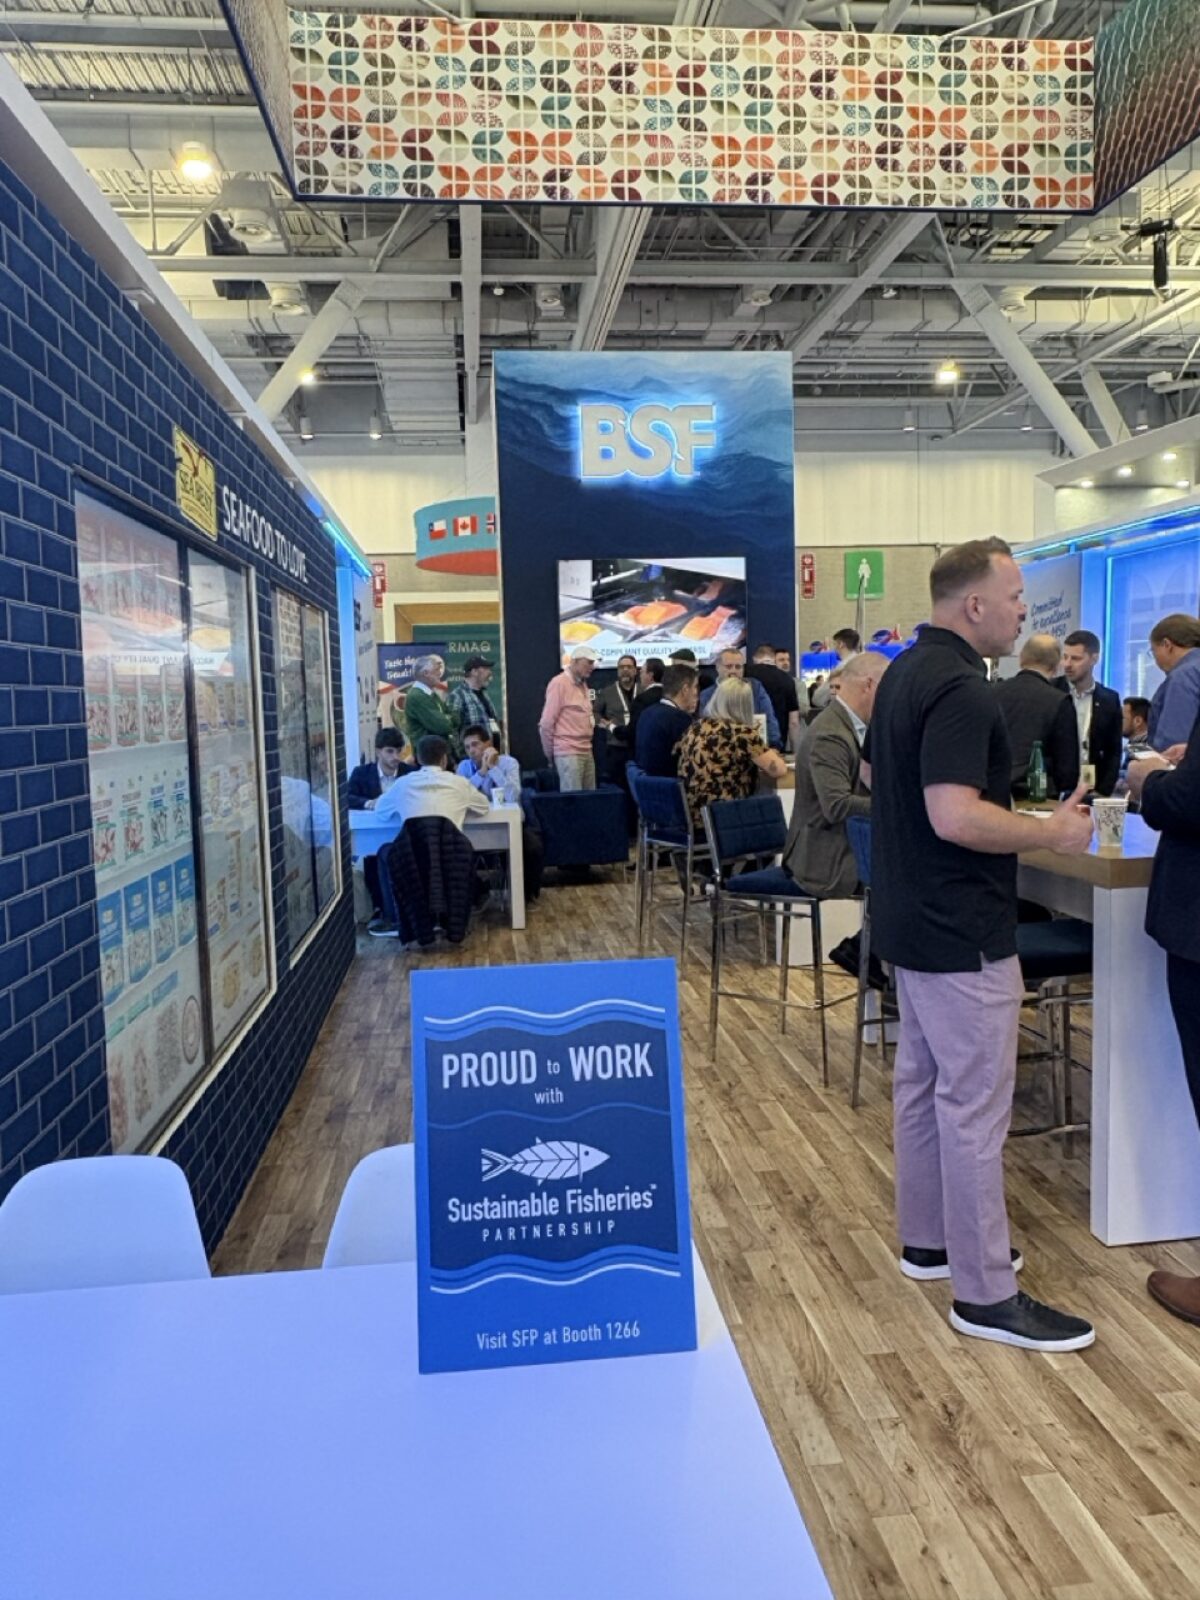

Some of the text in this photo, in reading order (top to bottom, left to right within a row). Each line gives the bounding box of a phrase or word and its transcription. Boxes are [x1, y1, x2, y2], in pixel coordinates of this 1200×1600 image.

[579, 403, 715, 476] BSF
[222, 484, 276, 560] SEAFOOD
[274, 529, 288, 570] TO
[448, 640, 491, 653] RMAQ
[442, 1042, 654, 1089] PROUD to WORK
[534, 1087, 564, 1104] with
[448, 1191, 560, 1222] Sustainable
[482, 1219, 615, 1242] PARTNERSHIP
[476, 1320, 641, 1350] Visit SFP at Booth 1266
